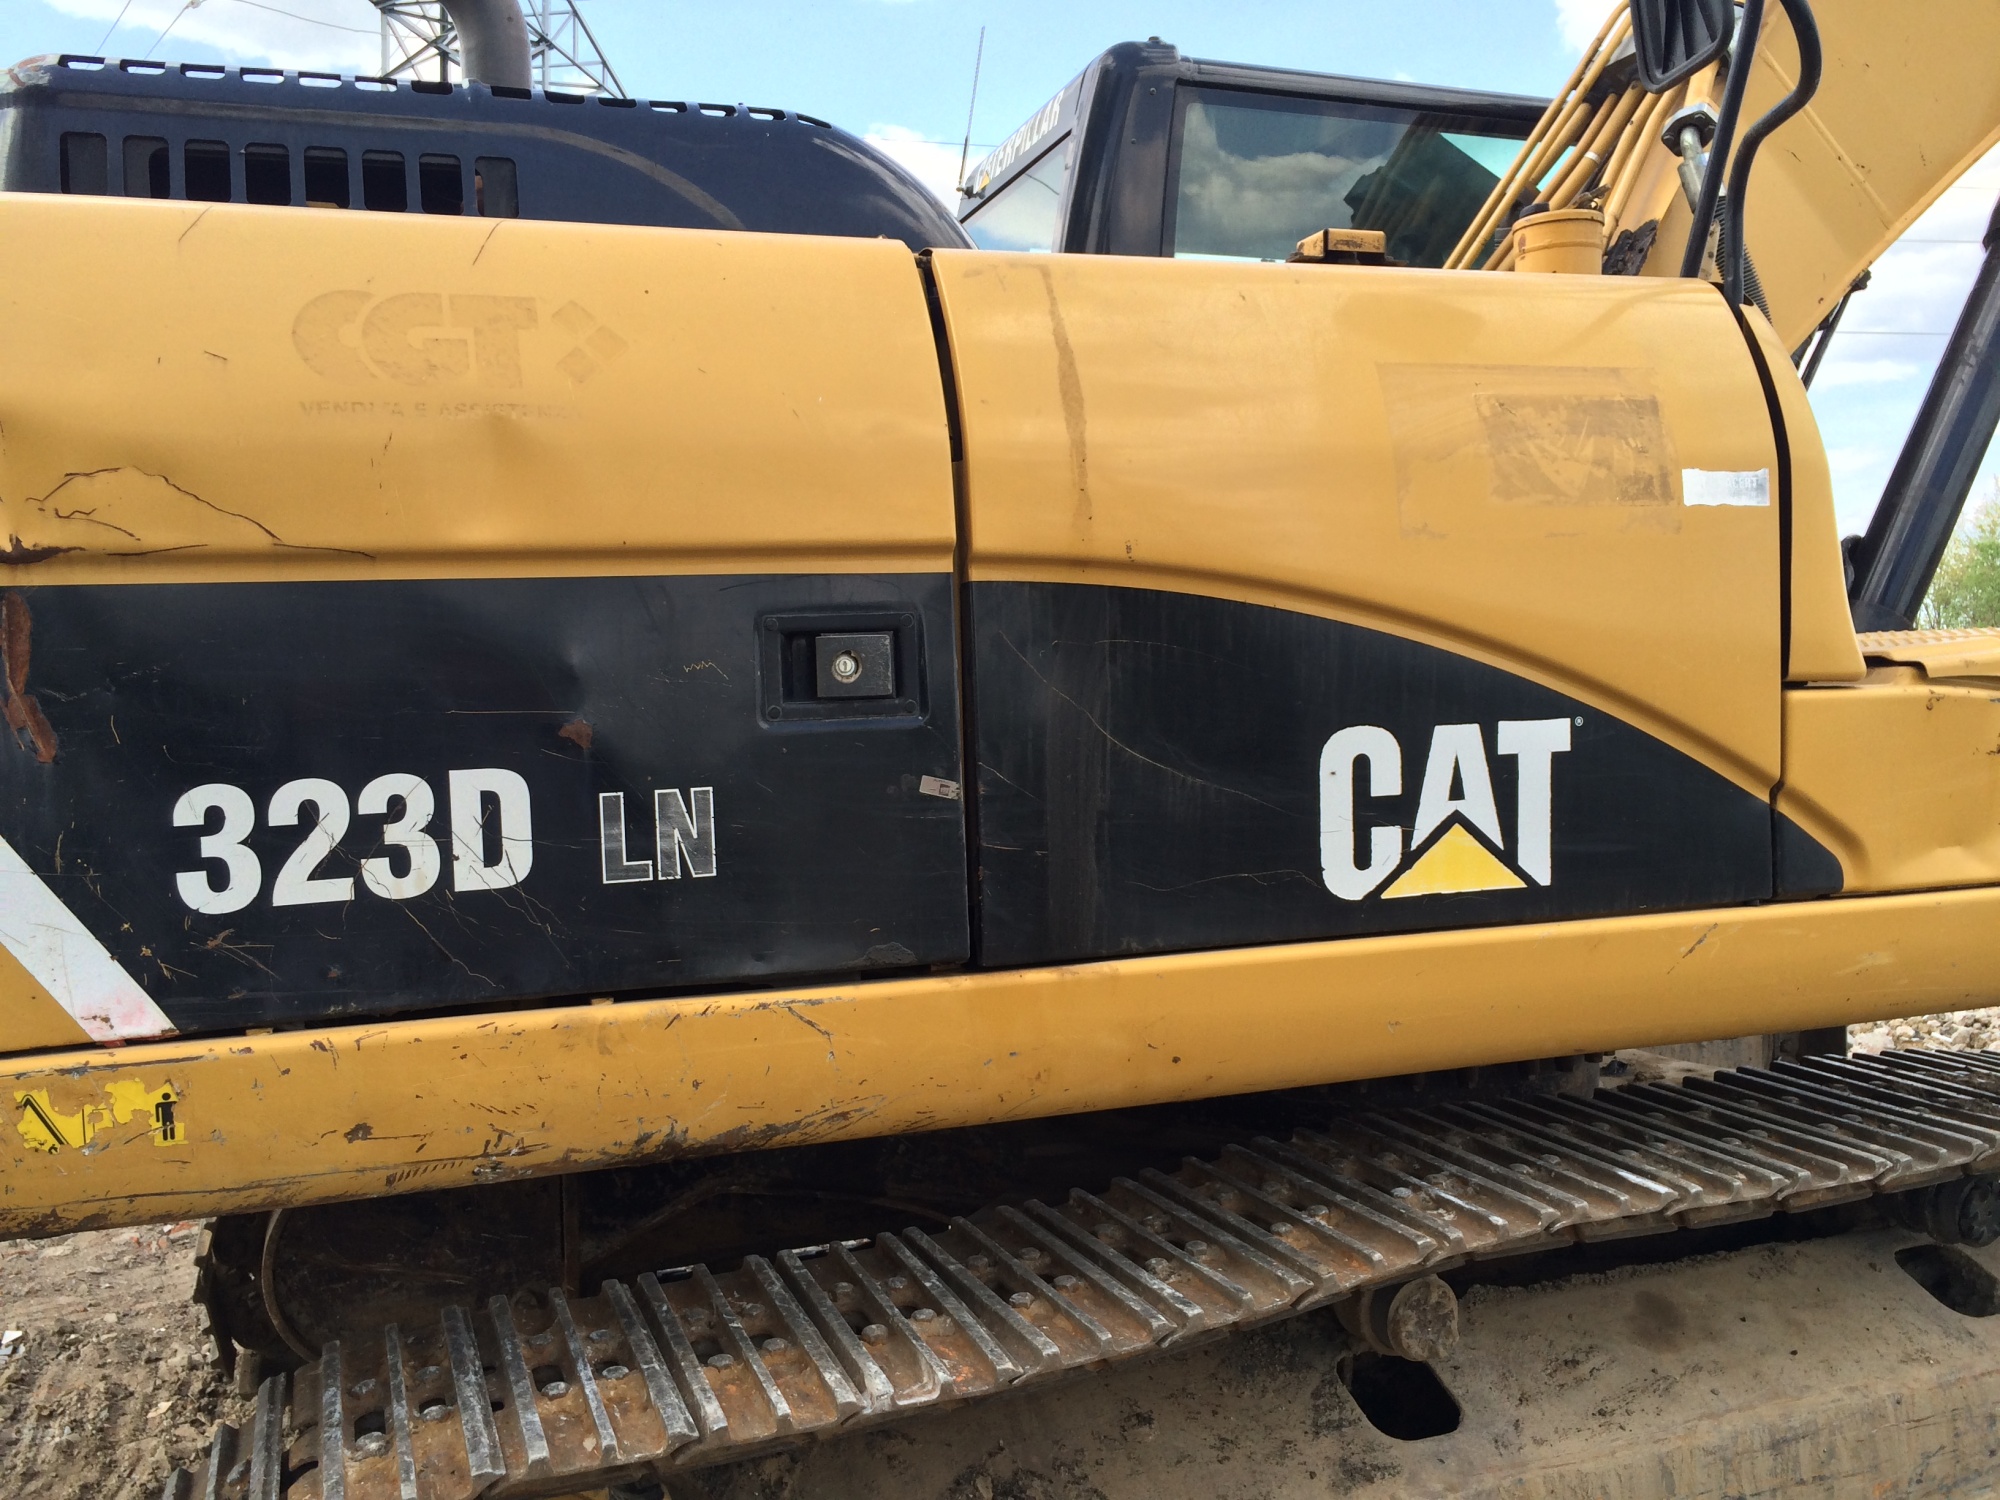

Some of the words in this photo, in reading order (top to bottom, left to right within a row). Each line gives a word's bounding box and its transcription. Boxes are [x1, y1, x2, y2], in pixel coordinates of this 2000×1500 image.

[974, 88, 1065, 194] CATERPILLAR
[173, 768, 534, 914] 323D
[599, 786, 717, 884] LN
[1319, 718, 1572, 900] CAT
